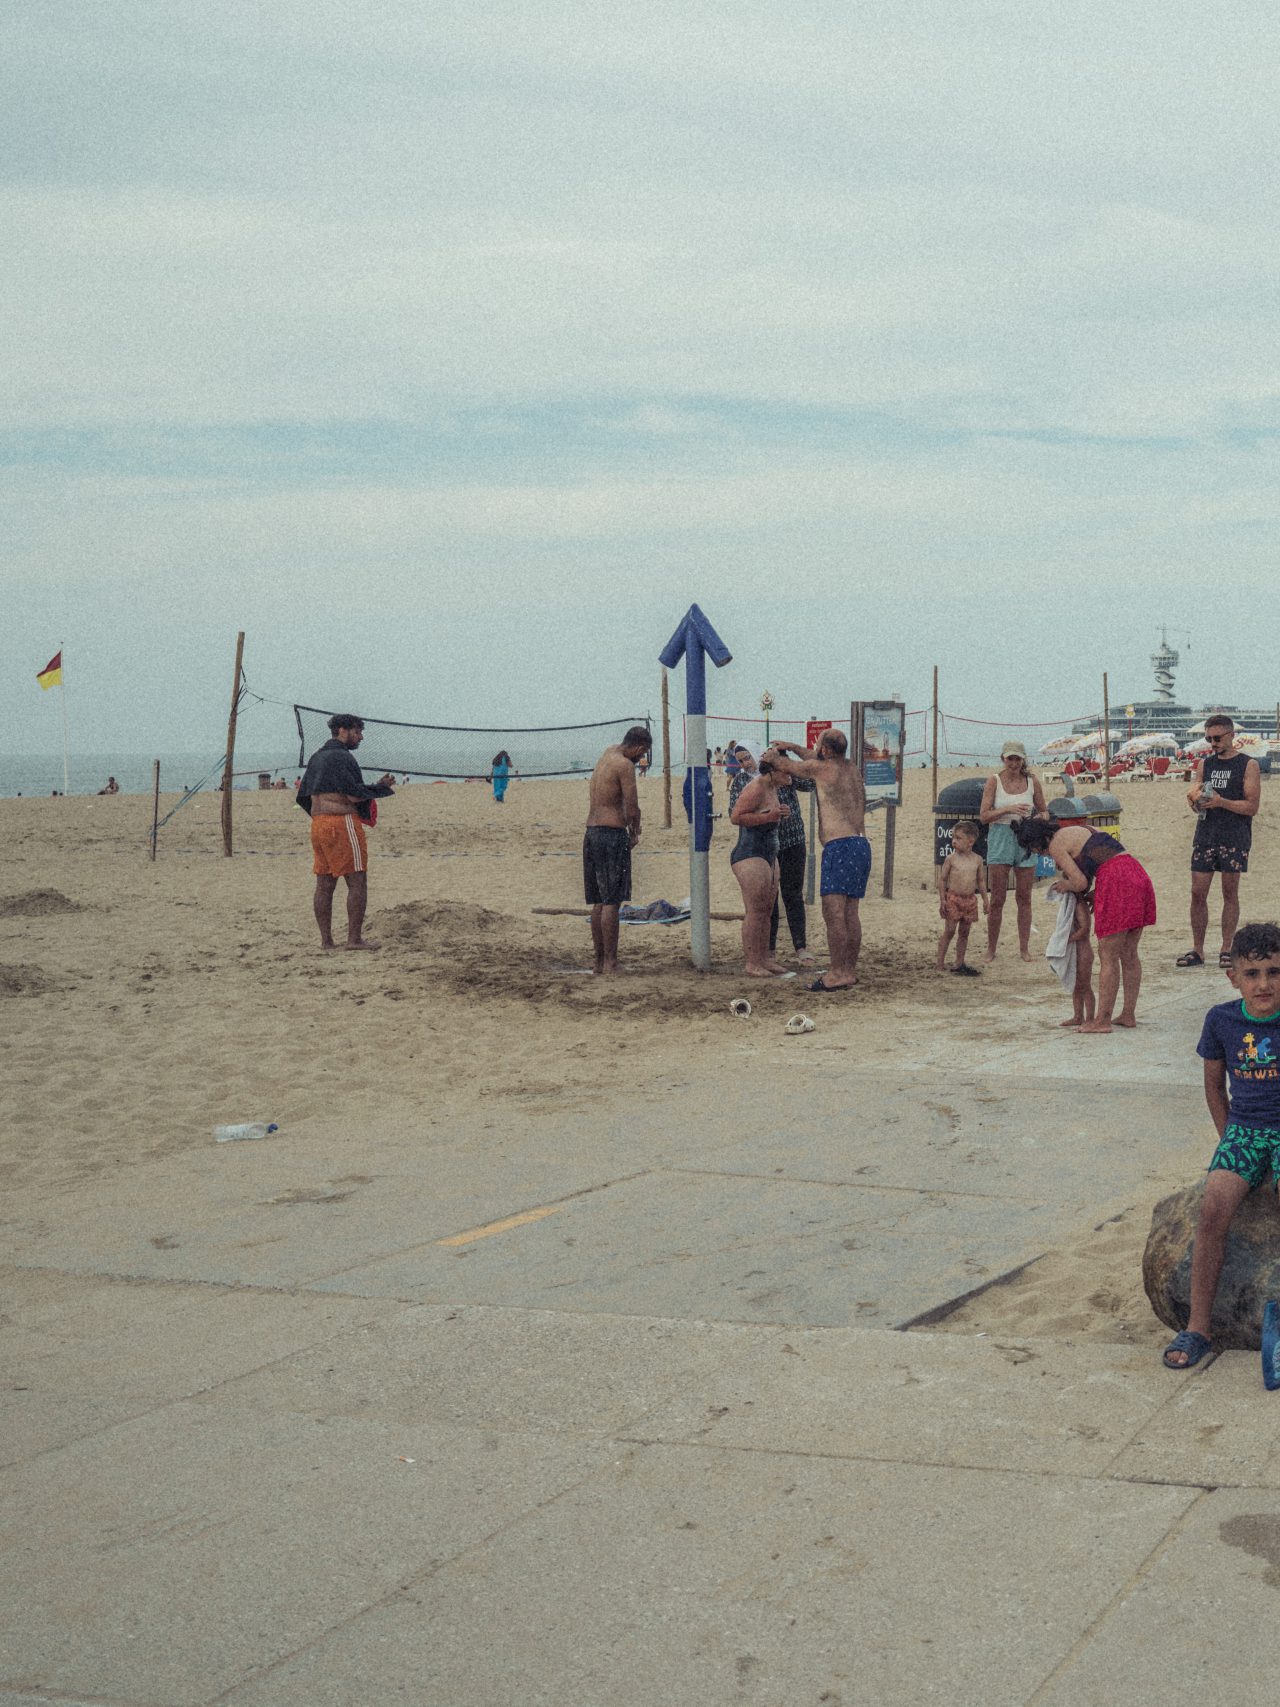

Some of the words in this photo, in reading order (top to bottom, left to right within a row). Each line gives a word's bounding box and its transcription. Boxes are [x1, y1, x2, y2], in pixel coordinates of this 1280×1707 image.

[1211, 770, 1231, 779] CALVIN
[1212, 779, 1228, 789] KLEIN
[937, 826, 953, 839] Ove
